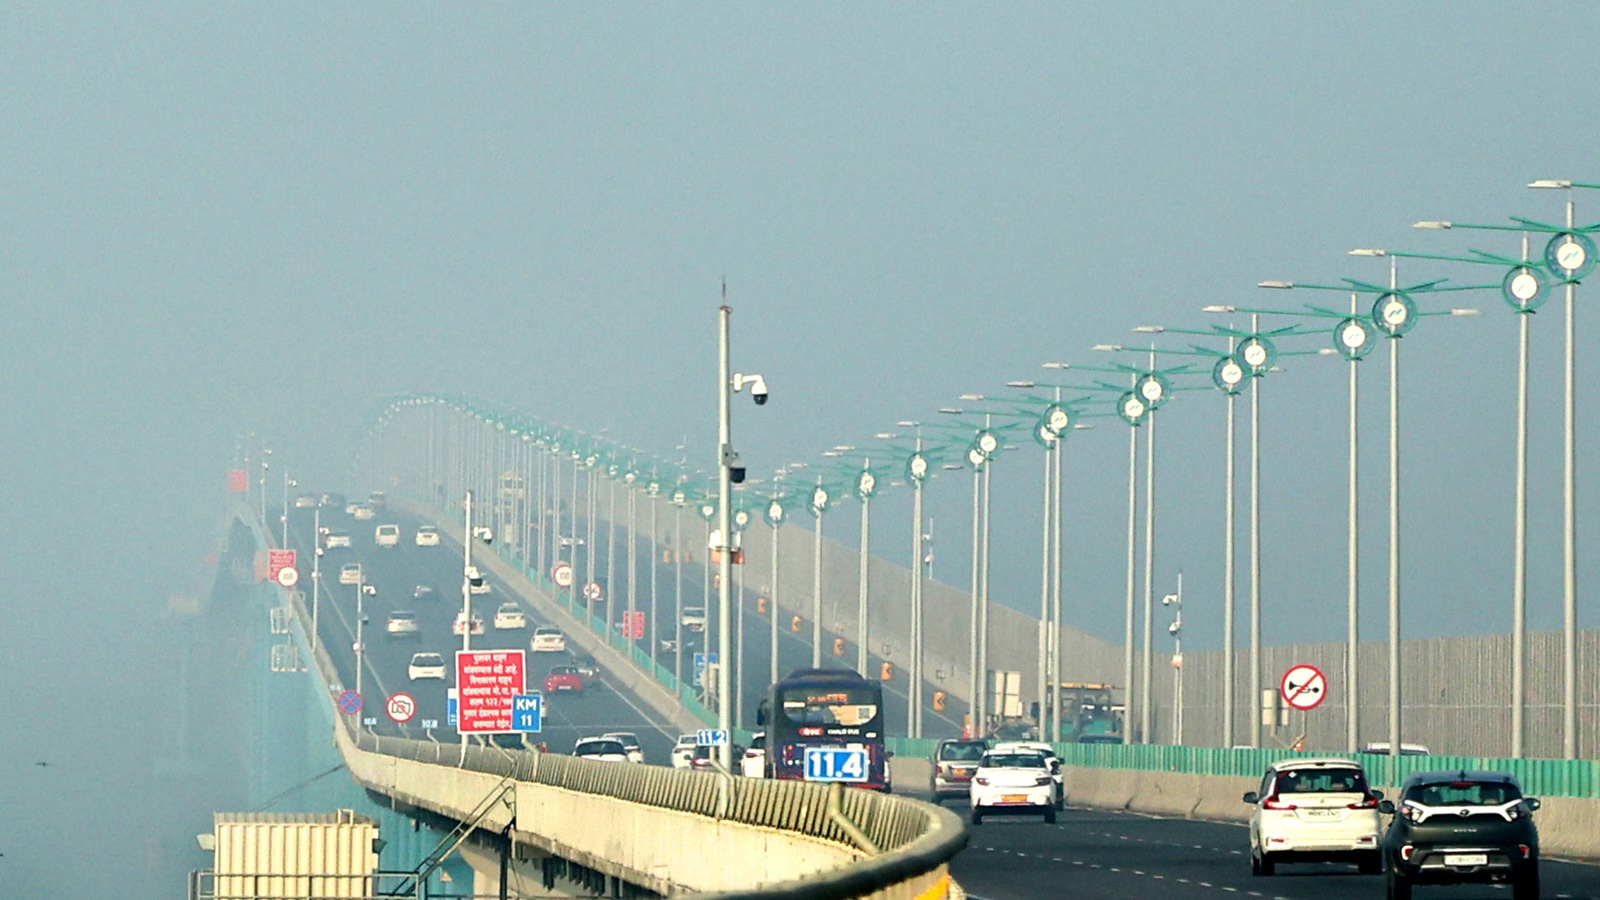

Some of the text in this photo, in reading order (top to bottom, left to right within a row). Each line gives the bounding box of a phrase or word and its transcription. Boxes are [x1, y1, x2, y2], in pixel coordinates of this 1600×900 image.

[516, 698, 537, 711] KM
[521, 714, 532, 727] 11
[699, 730, 726, 744] 11.2
[809, 751, 863, 777] 11.4
